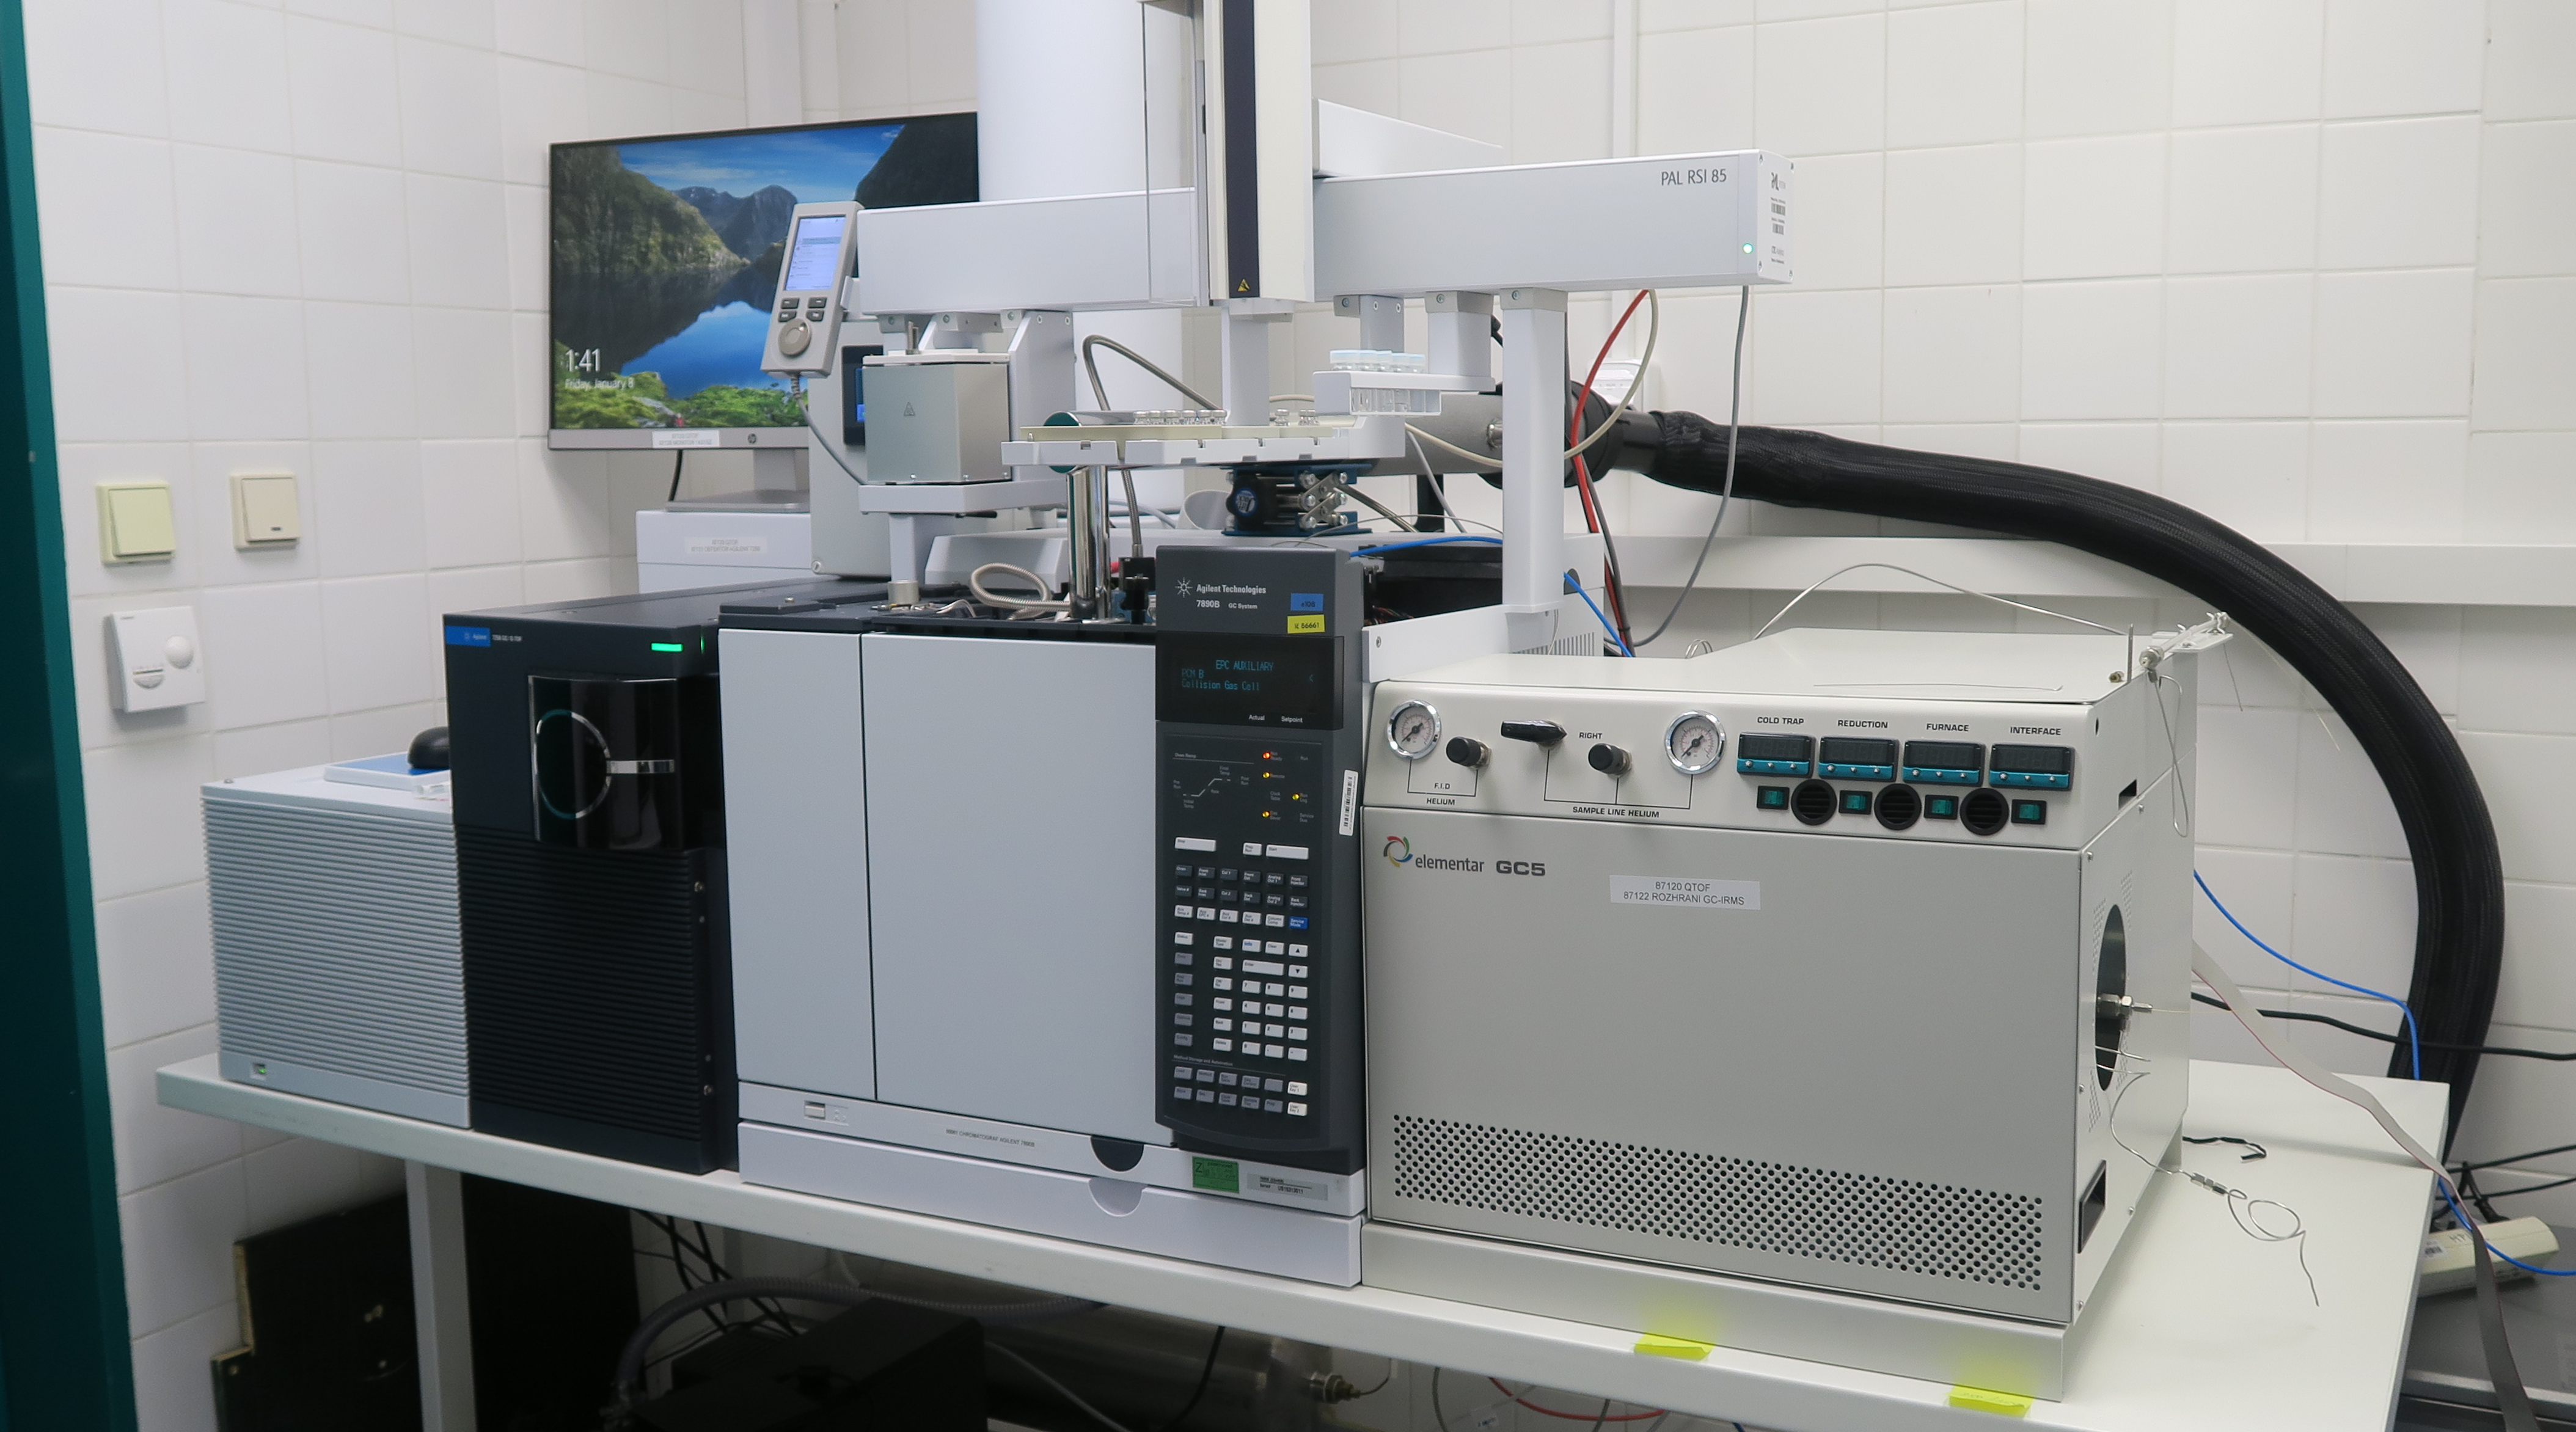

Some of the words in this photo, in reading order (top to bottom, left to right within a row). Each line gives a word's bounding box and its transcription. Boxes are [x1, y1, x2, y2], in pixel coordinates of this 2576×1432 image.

[1661, 171, 1683, 186] PAL
[1688, 169, 1707, 184] RSI
[1711, 169, 1727, 183] 85
[565, 348, 601, 373] 1:41
[594, 378, 626, 391] January
[1196, 583, 1220, 594] Agilent
[1221, 585, 1267, 595] Technologies
[1196, 599, 1220, 608] 7890B
[1215, 660, 1229, 670] EPC
[1233, 660, 1274, 671] AUXILIARY
[1198, 670, 1204, 679] B
[1181, 678, 1221, 689] Collision
[1224, 681, 1238, 690] Gas
[1242, 681, 1259, 691] Cell
[1837, 719, 1889, 729] REDUCTION
[1926, 723, 1969, 732] FURNACE
[2010, 726, 2062, 736] INTERFACE
[1426, 797, 1455, 806] HELIUM
[1573, 806, 1605, 815] SAMPLE
[1607, 808, 1626, 816] LINE
[1628, 809, 1659, 819] HELIUM
[1415, 854, 1485, 872] elementar
[1496, 860, 1546, 876] GC5
[1655, 881, 1682, 891] 87120
[1684, 882, 1711, 892] QTOF
[1623, 891, 1650, 900] 87122
[1652, 893, 1701, 903] ROZHRANI
[1703, 895, 1745, 905] GC-IRMS
[1195, 1162, 1202, 1173] Z
